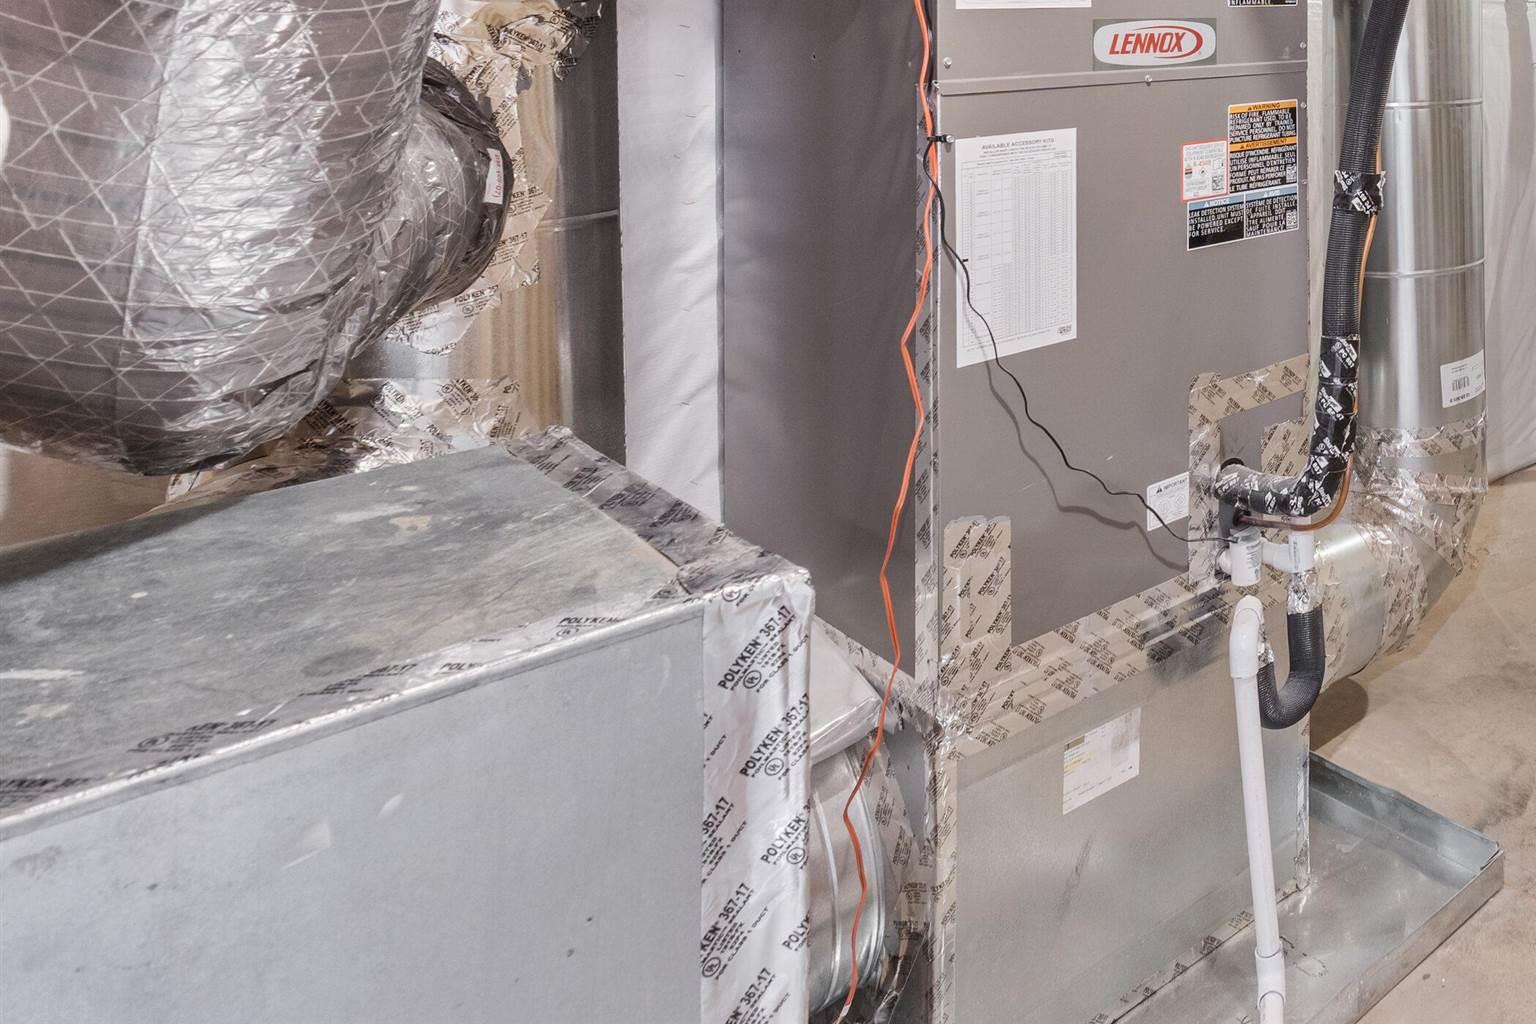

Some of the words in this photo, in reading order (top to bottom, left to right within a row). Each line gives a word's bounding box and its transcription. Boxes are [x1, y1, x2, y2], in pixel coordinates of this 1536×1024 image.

[1109, 32, 1185, 55] LENNOX
[1246, 139, 1287, 147] AVERTISSEMENT
[1238, 161, 1265, 170] PERSONNEL
[1201, 206, 1226, 215] DETECTION
[1210, 198, 1230, 206] NOTICE
[1197, 220, 1223, 229] POWERED
[1224, 216, 1244, 224] EXCEPT
[770, 614, 797, 642] SEALANT
[718, 638, 761, 691] POLYKEN
[760, 605, 792, 638] 367-17
[757, 641, 779, 665] LISTED
[756, 678, 770, 693] FOR
[710, 734, 727, 756] DUCT
[739, 727, 784, 777] POLYKEN
[702, 796, 730, 835] 367-17
[730, 820, 748, 843] DUCT
[760, 814, 807, 866] POLYKEN
[719, 882, 750, 921] 367-17
[752, 906, 769, 929] DUCT
[740, 967, 772, 1006] 367-17
